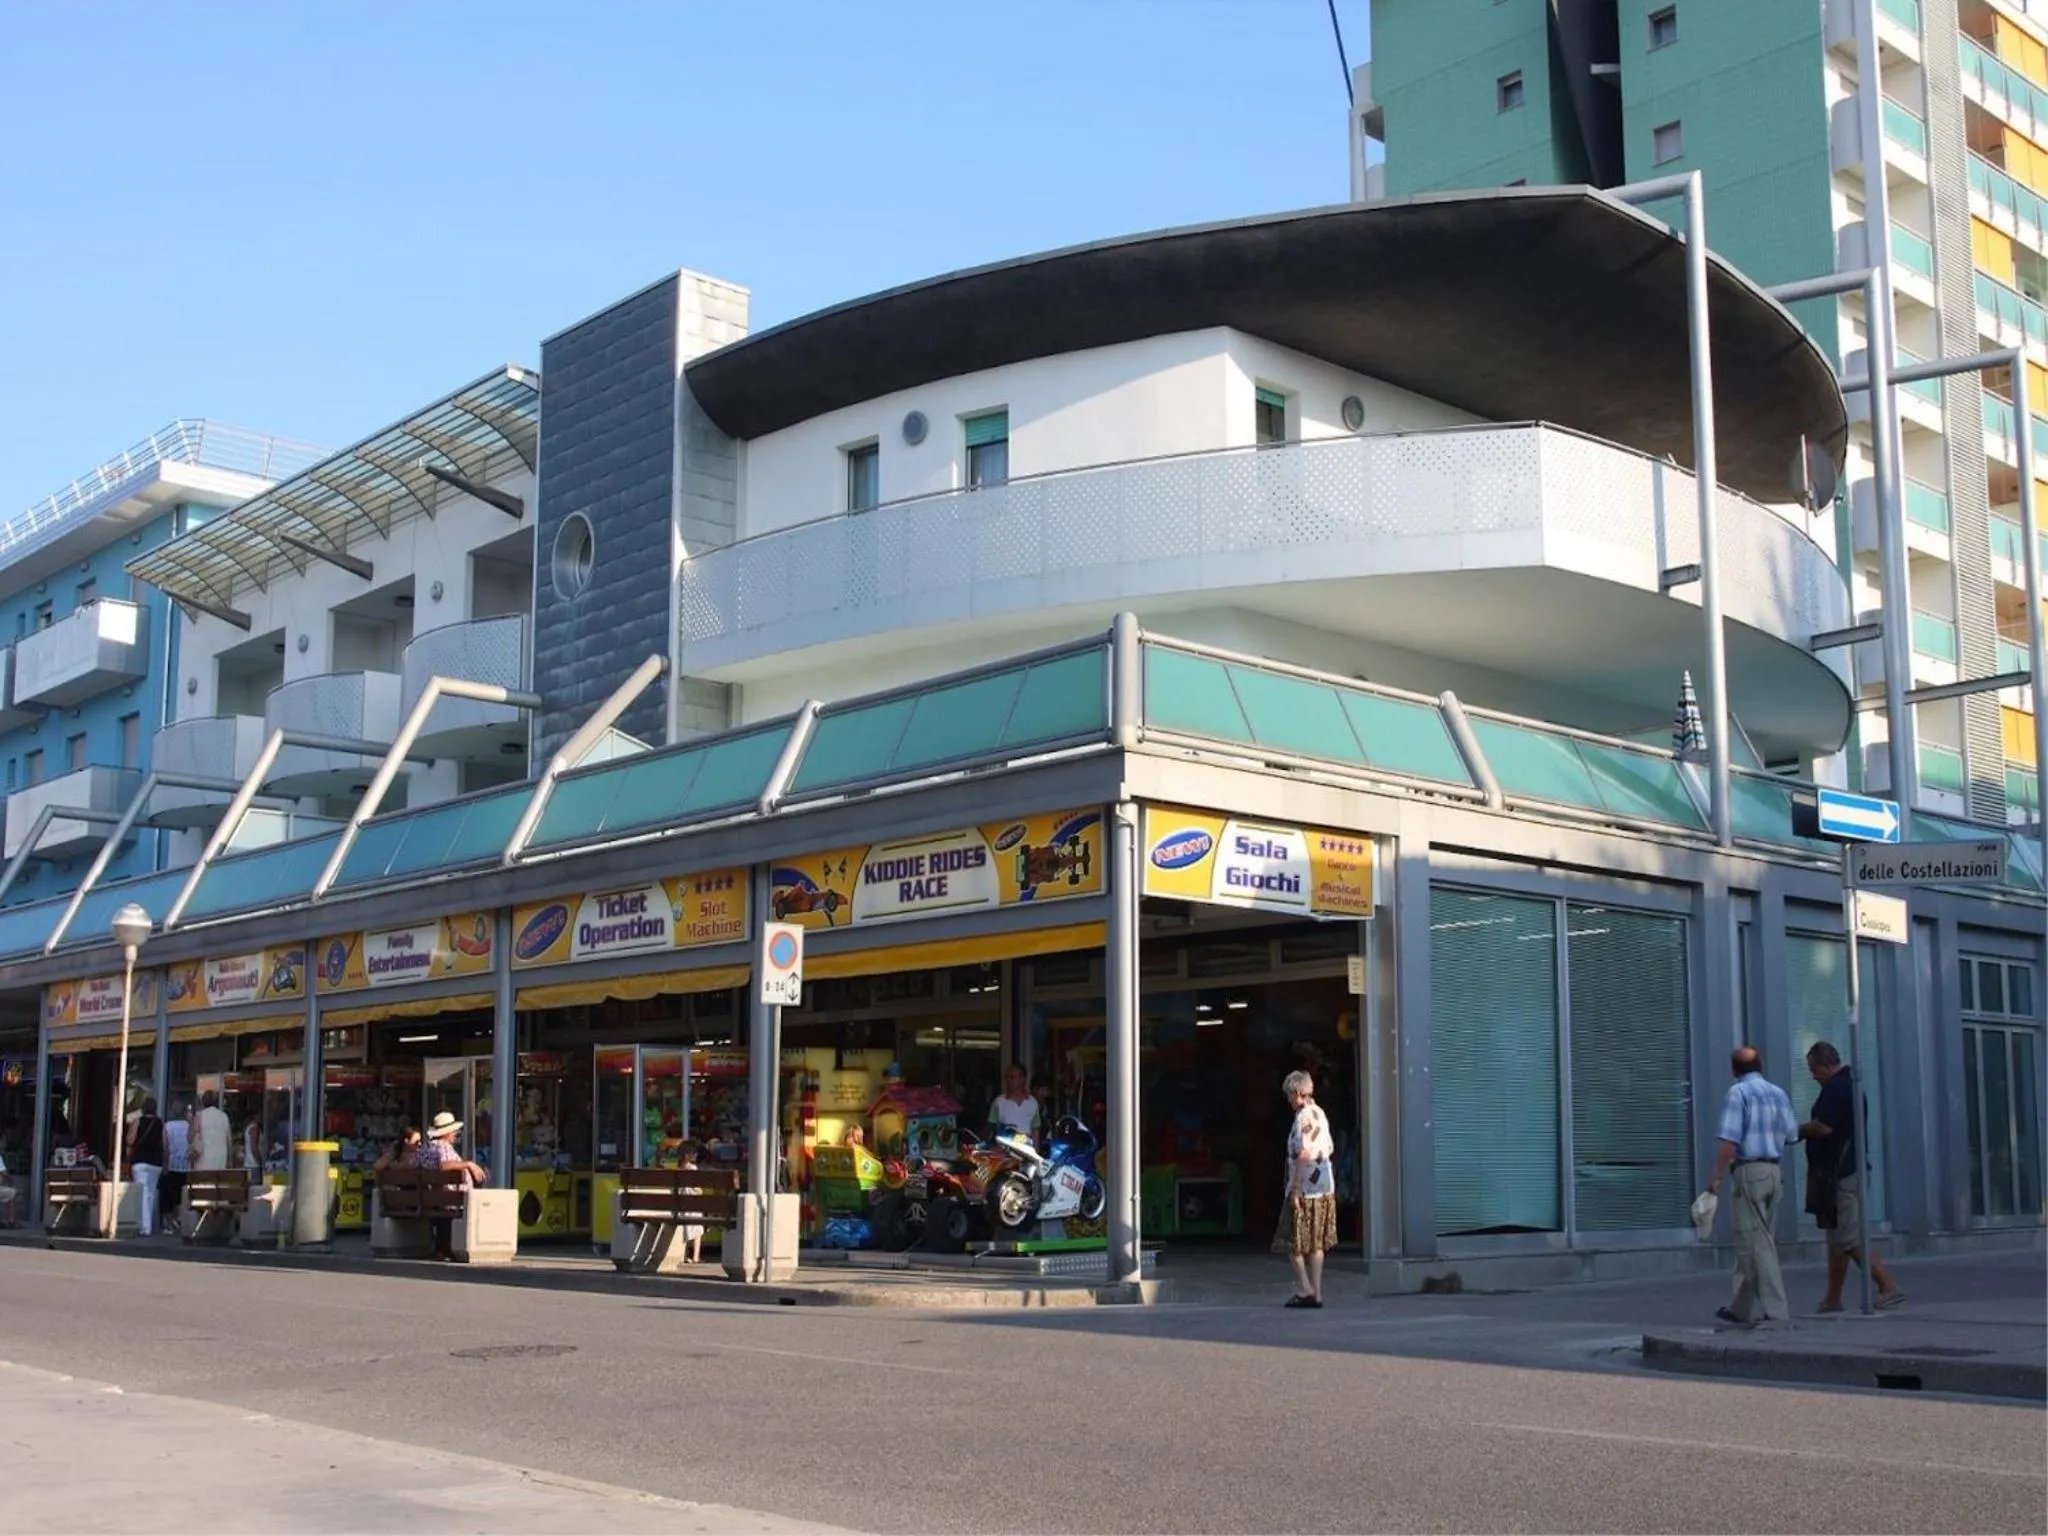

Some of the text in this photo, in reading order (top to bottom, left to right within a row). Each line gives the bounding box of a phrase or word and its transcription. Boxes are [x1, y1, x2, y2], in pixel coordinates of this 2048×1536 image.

[1235, 835, 1288, 860] Sala
[864, 845, 986, 885] KIDDIE RIDES
[1859, 860, 1998, 880] delle Costellazioni
[899, 876, 948, 903] RACE
[1226, 866, 1300, 893] Giochi
[596, 893, 648, 919] Ticket
[700, 900, 728, 918] Slot
[1317, 893, 1368, 909] Machines
[579, 916, 665, 949] Operation
[686, 918, 743, 938] Machine
